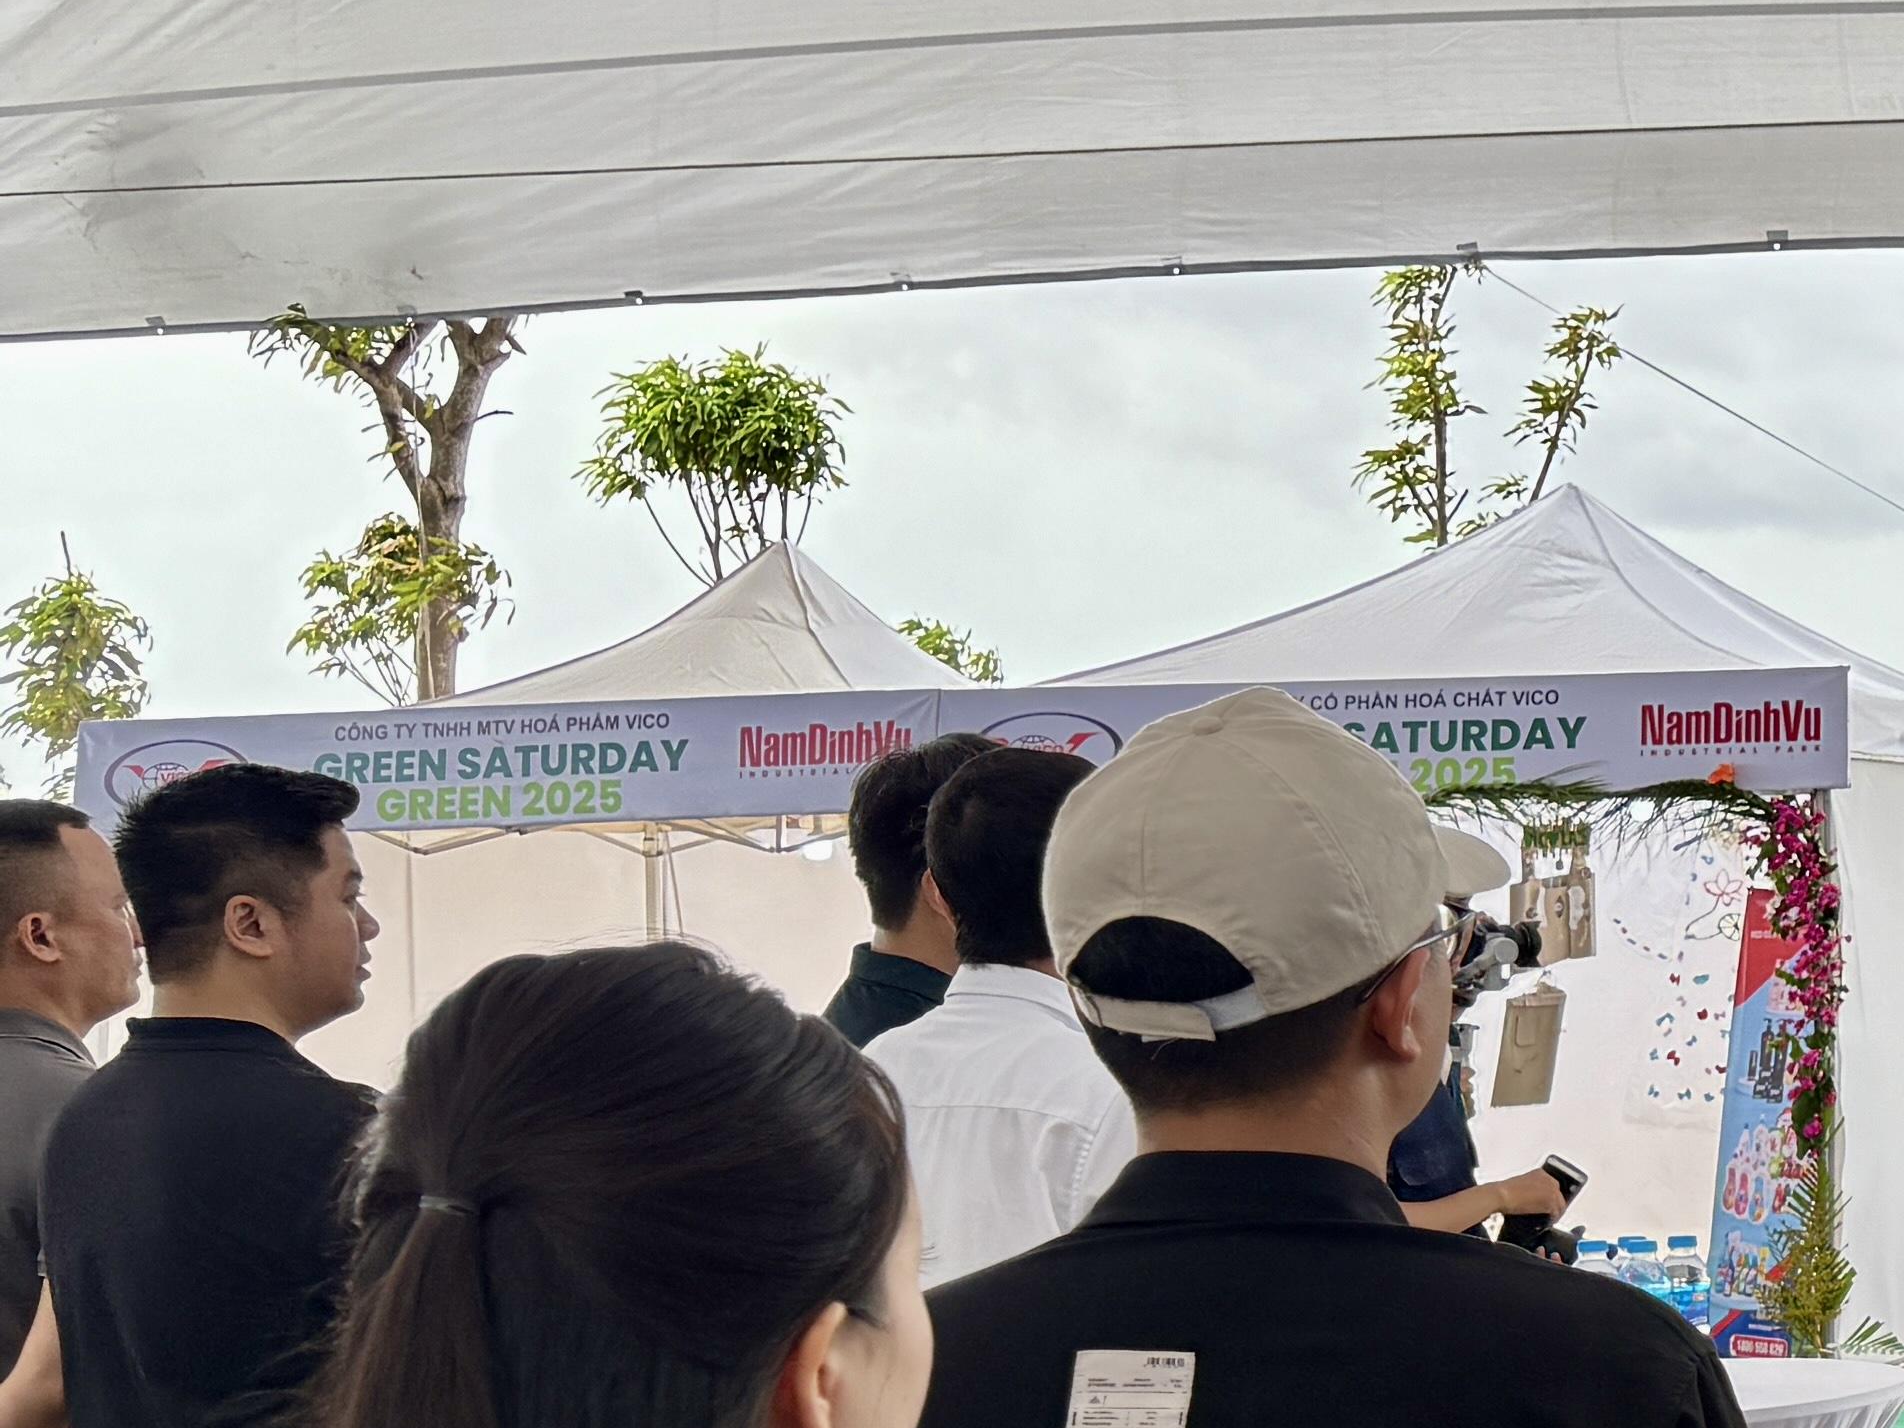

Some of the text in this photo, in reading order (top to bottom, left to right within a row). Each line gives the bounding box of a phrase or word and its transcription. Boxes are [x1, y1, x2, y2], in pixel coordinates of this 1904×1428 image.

[1512, 689, 1560, 707] VICO
[334, 723, 389, 742] CÔNG
[394, 722, 417, 739] TY
[422, 721, 472, 739] TNHH
[477, 719, 515, 736] MTV
[624, 712, 671, 731] VICO
[1640, 699, 1822, 746] NamDinhVu
[312, 738, 690, 784] GREEN SATURDAY
[1640, 744, 1821, 757] INDUSTRIAL PARK
[1409, 756, 1517, 794] 2025
[375, 778, 623, 822] GREEN 2025
